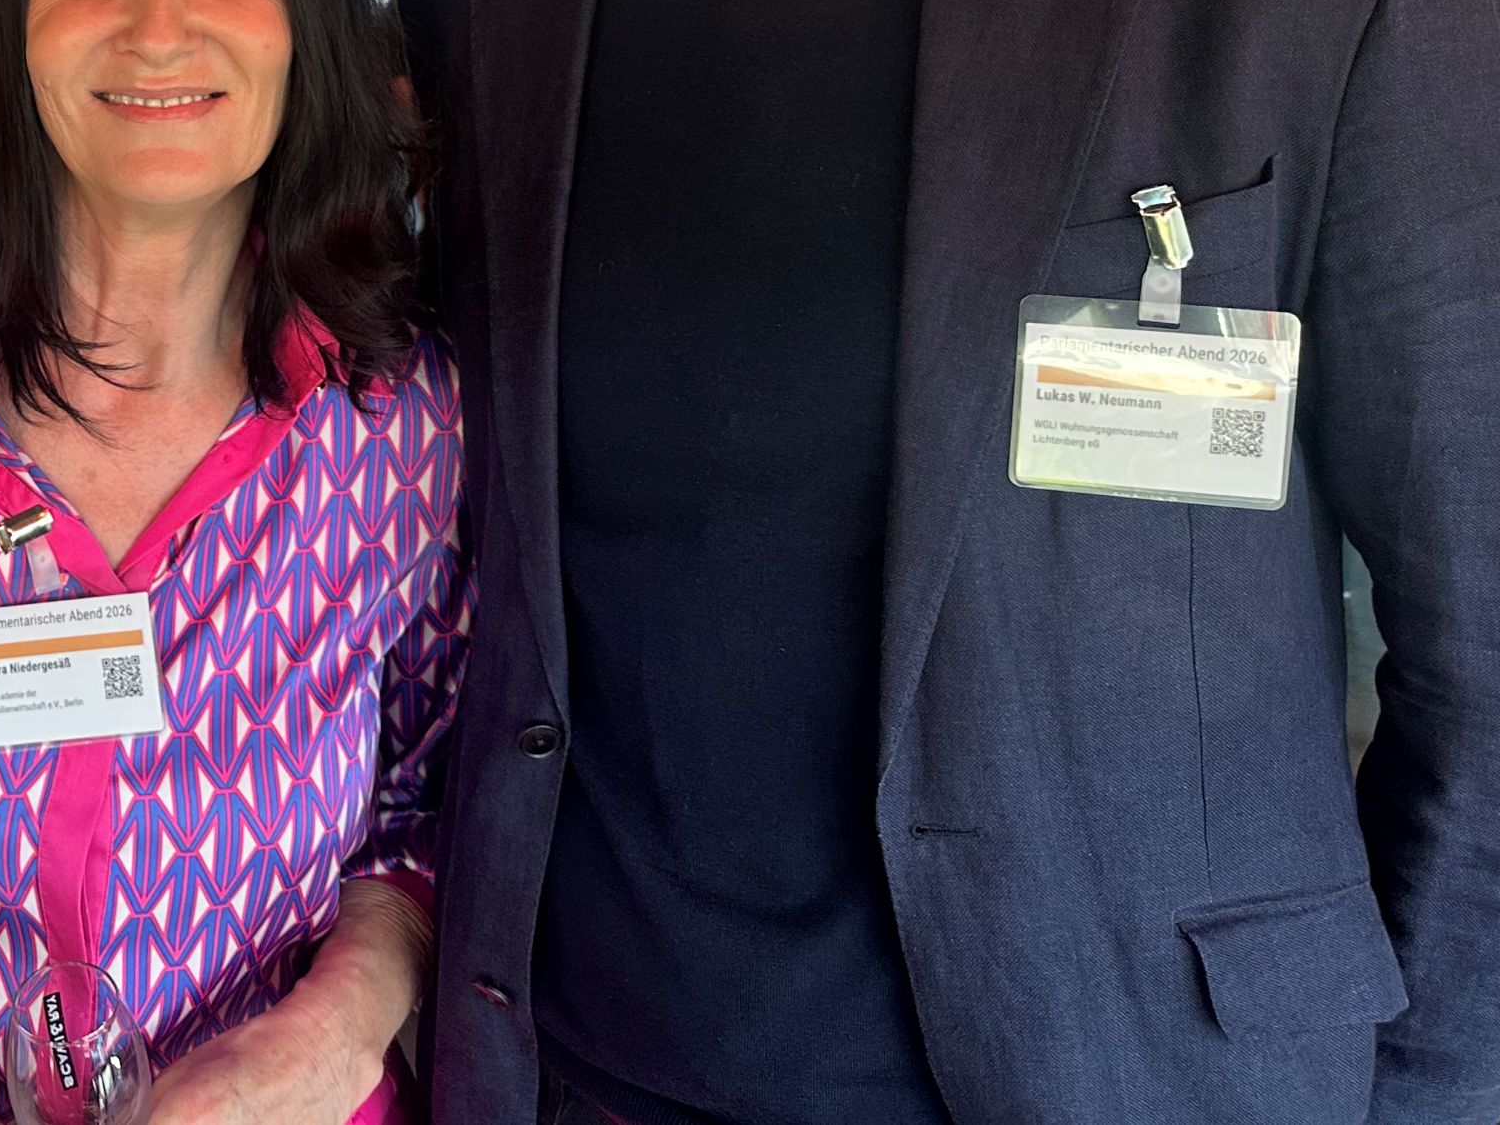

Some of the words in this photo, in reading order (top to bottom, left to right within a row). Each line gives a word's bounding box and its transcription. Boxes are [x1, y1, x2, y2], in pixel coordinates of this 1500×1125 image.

[1177, 346, 1225, 362] Abend
[1229, 349, 1267, 365] 2026
[1036, 388, 1075, 403] Lukas
[1079, 391, 1096, 405] W.
[1099, 393, 1162, 410] Neumann
[1060, 421, 1179, 441] Wohnungsgenossenschaft
[1033, 434, 1085, 449] Lichtenberg
[1087, 439, 1100, 448] eG
[69, 607, 103, 622] Abend
[105, 604, 133, 618] 2026
[10, 657, 71, 674] Niedergesäß
[26, 689, 37, 698] der
[64, 697, 84, 707] Berlin
